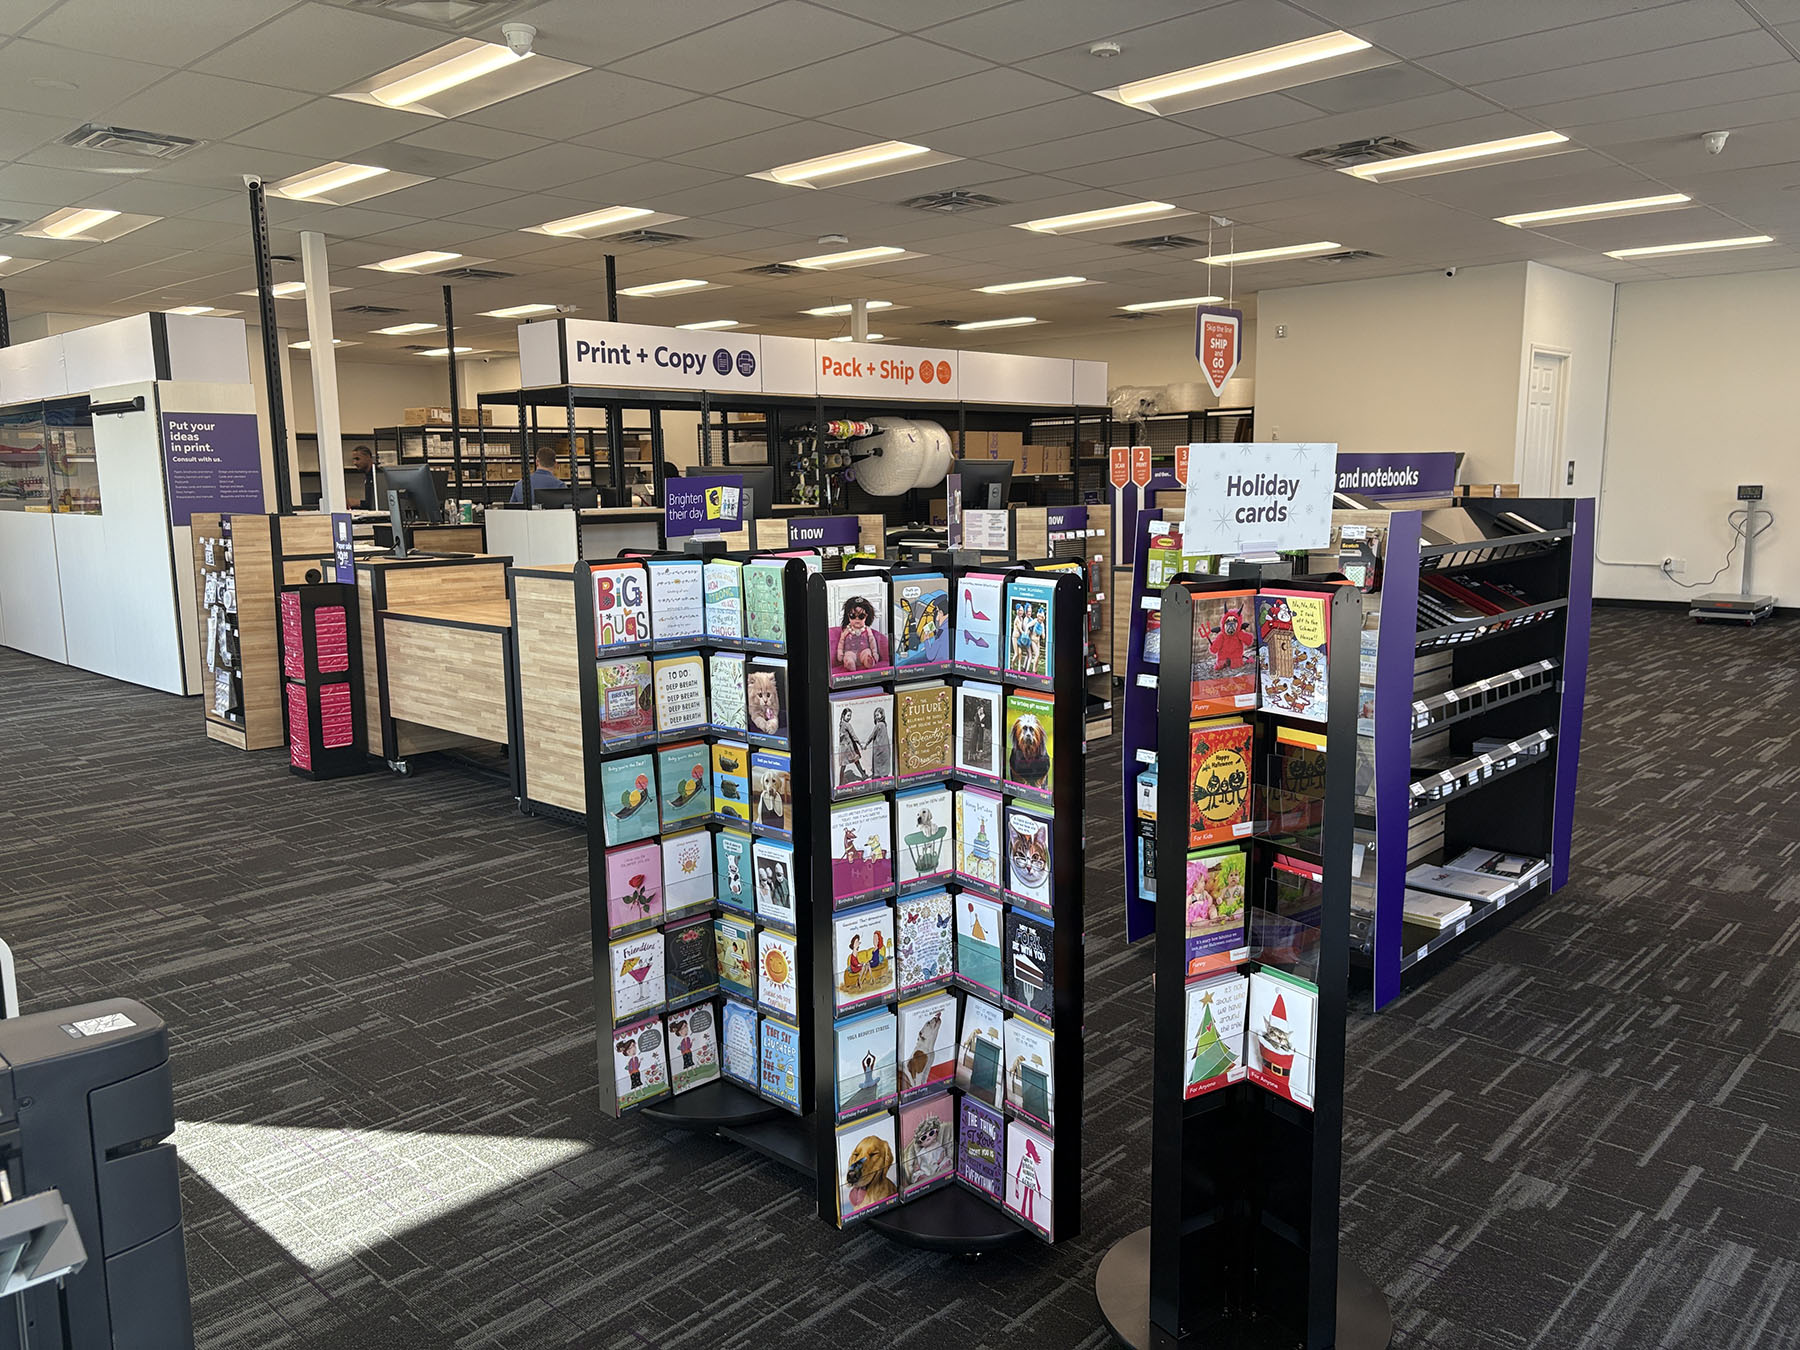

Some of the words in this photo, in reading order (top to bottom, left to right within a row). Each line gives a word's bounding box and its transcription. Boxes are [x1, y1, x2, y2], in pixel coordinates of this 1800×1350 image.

[1211, 338, 1228, 349] SHIP
[576, 340, 631, 365] Print
[637, 349, 648, 363] +
[654, 346, 706, 375] Copy
[1213, 358, 1224, 368] GO
[822, 356, 863, 377] Pack
[867, 362, 875, 376] +
[880, 360, 914, 385] Ship
[170, 421, 189, 431] Put
[191, 423, 215, 432] your
[170, 432, 199, 441] ideas
[171, 443, 181, 452] in
[184, 443, 214, 454] print.
[1118, 452, 1122, 462] 1
[1139, 452, 1144, 461] 2
[1182, 450, 1187, 460] 3
[1339, 468, 1358, 488] and
[1362, 466, 1419, 488] notebooks
[1227, 474, 1300, 501] Holiday
[669, 493, 703, 509] Brighten
[669, 509, 687, 521] their
[690, 508, 704, 522] day
[1236, 501, 1288, 524] cards
[1048, 516, 1064, 525] now
[790, 526, 798, 541] it
[801, 528, 824, 540] now
[600, 611, 648, 644] hugs
[711, 626, 736, 637] CHOICE
[669, 672, 678, 680] TO
[666, 682, 678, 691] DEEP
[680, 680, 698, 689] BREATH
[668, 694, 680, 702] DEEP
[681, 691, 699, 700] BREATH
[669, 704, 681, 713] DEEP
[682, 702, 700, 710] BREATH
[909, 703, 943, 715] FUTURE
[670, 716, 682, 724] DEEP
[683, 712, 701, 721] BREATH
[910, 728, 944, 748] Beauty
[1012, 941, 1020, 952] BE
[1021, 945, 1033, 957] WITH
[1034, 950, 1046, 962] YOU
[1215, 996, 1232, 1006] about
[1228, 1003, 1242, 1012] have
[1219, 1012, 1240, 1023] around
[766, 1024, 780, 1040] THEY
[782, 1032, 791, 1044] SAY
[876, 1025, 890, 1033] STRESS
[1221, 1025, 1230, 1033] the
[764, 1038, 796, 1057] LAUGHTER
[765, 1049, 772, 1059] IS
[763, 1059, 775, 1071] THE
[763, 1070, 780, 1086] BEST
[1261, 1076, 1278, 1089] Anyone
[1199, 1082, 1216, 1091] Anyone
[968, 1112, 978, 1127] THE
[980, 1118, 996, 1140] THING
[982, 1148, 990, 1156] YOU
[966, 1165, 995, 1193] EVERYTHING
